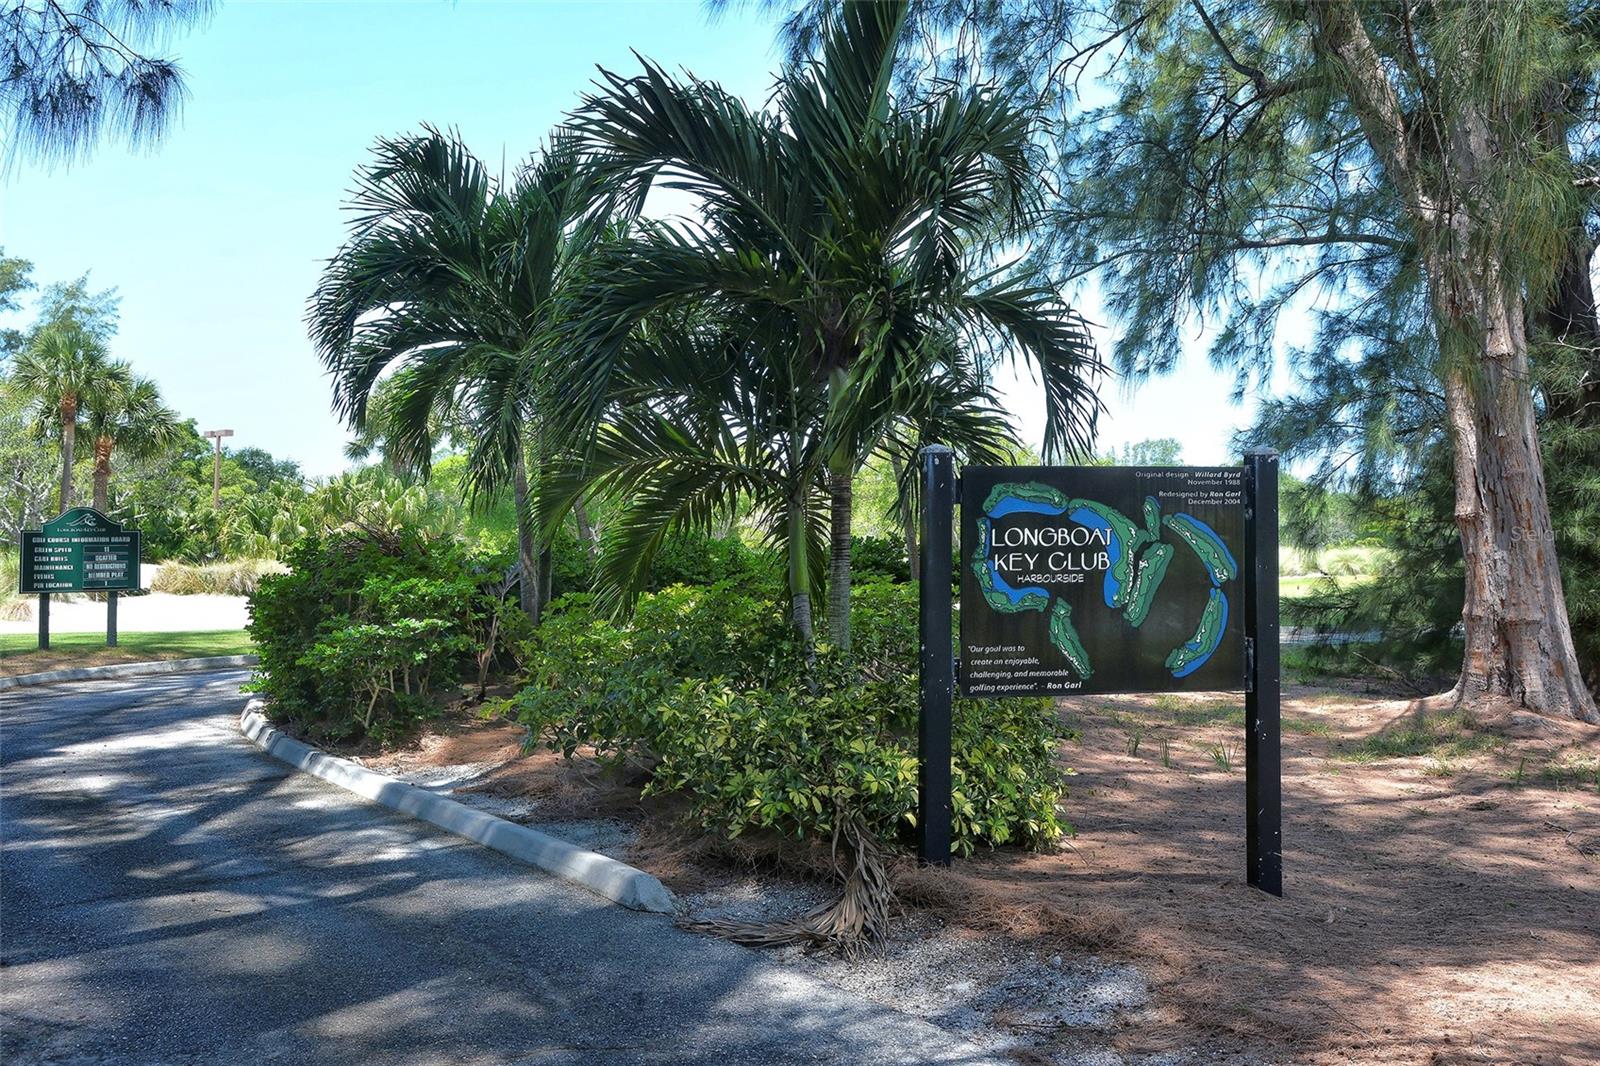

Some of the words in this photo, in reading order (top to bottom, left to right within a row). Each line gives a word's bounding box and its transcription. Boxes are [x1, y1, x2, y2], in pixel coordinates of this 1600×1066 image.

[1135, 471, 1164, 479] Original
[1165, 471, 1189, 479] design
[1223, 471, 1241, 479] Byrd
[991, 527, 1113, 547] LONGBOAT
[994, 552, 1040, 571] KEY
[1048, 552, 1111, 571] CLUB
[1017, 573, 1084, 583] HARBOURSIDE
[985, 645, 1001, 654] goal
[970, 658, 993, 666] create
[1004, 657, 1040, 667] enjoyable,
[969, 670, 1013, 679] challenging,
[1028, 669, 1069, 677] memorable
[969, 684, 995, 693] golfing
[1046, 682, 1062, 690] Ron
[1064, 681, 1082, 689] Garl
